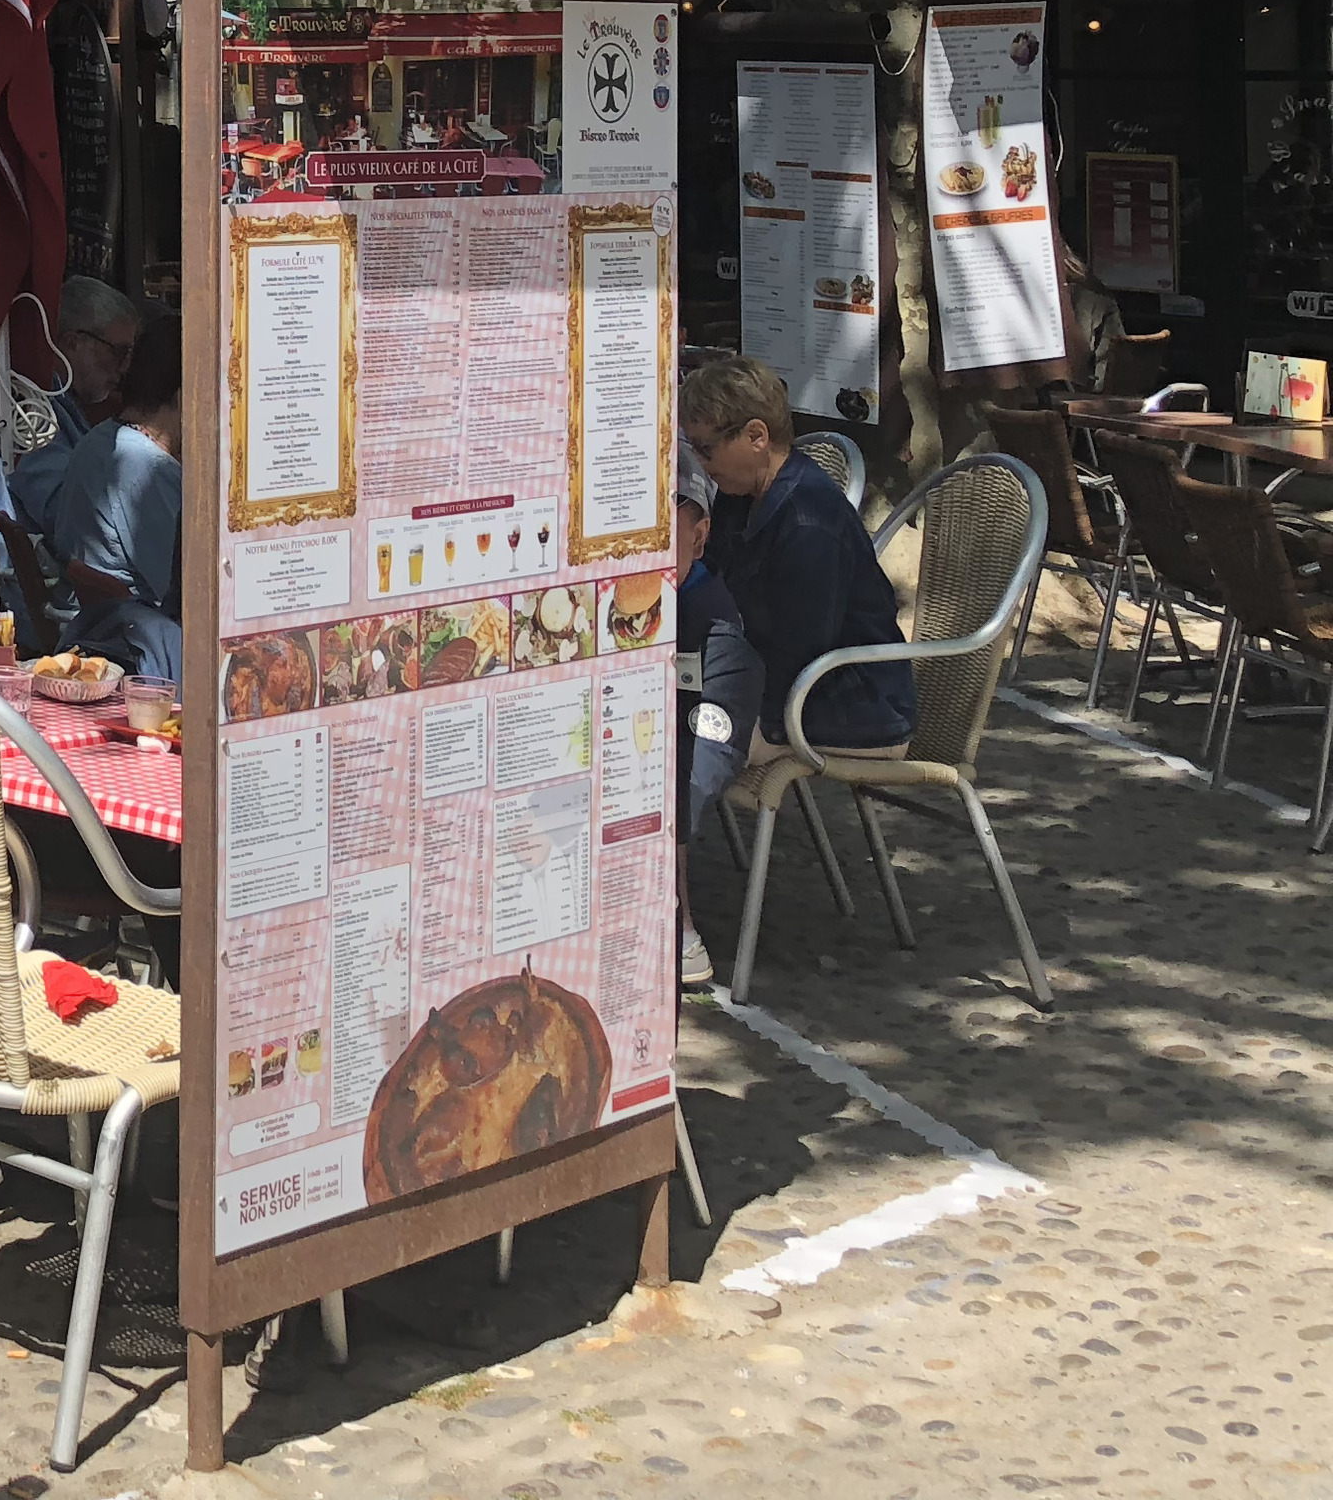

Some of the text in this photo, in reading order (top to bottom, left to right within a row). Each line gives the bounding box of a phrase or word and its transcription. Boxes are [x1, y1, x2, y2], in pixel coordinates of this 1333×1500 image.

[331, 162, 356, 176] PLUS
[358, 162, 391, 176] VIEUX
[393, 158, 419, 175] CAFÉ
[422, 161, 436, 174] DE
[439, 161, 452, 174] LA
[239, 1173, 301, 1209] SERVICE
[240, 1192, 301, 1226] NON STOP
